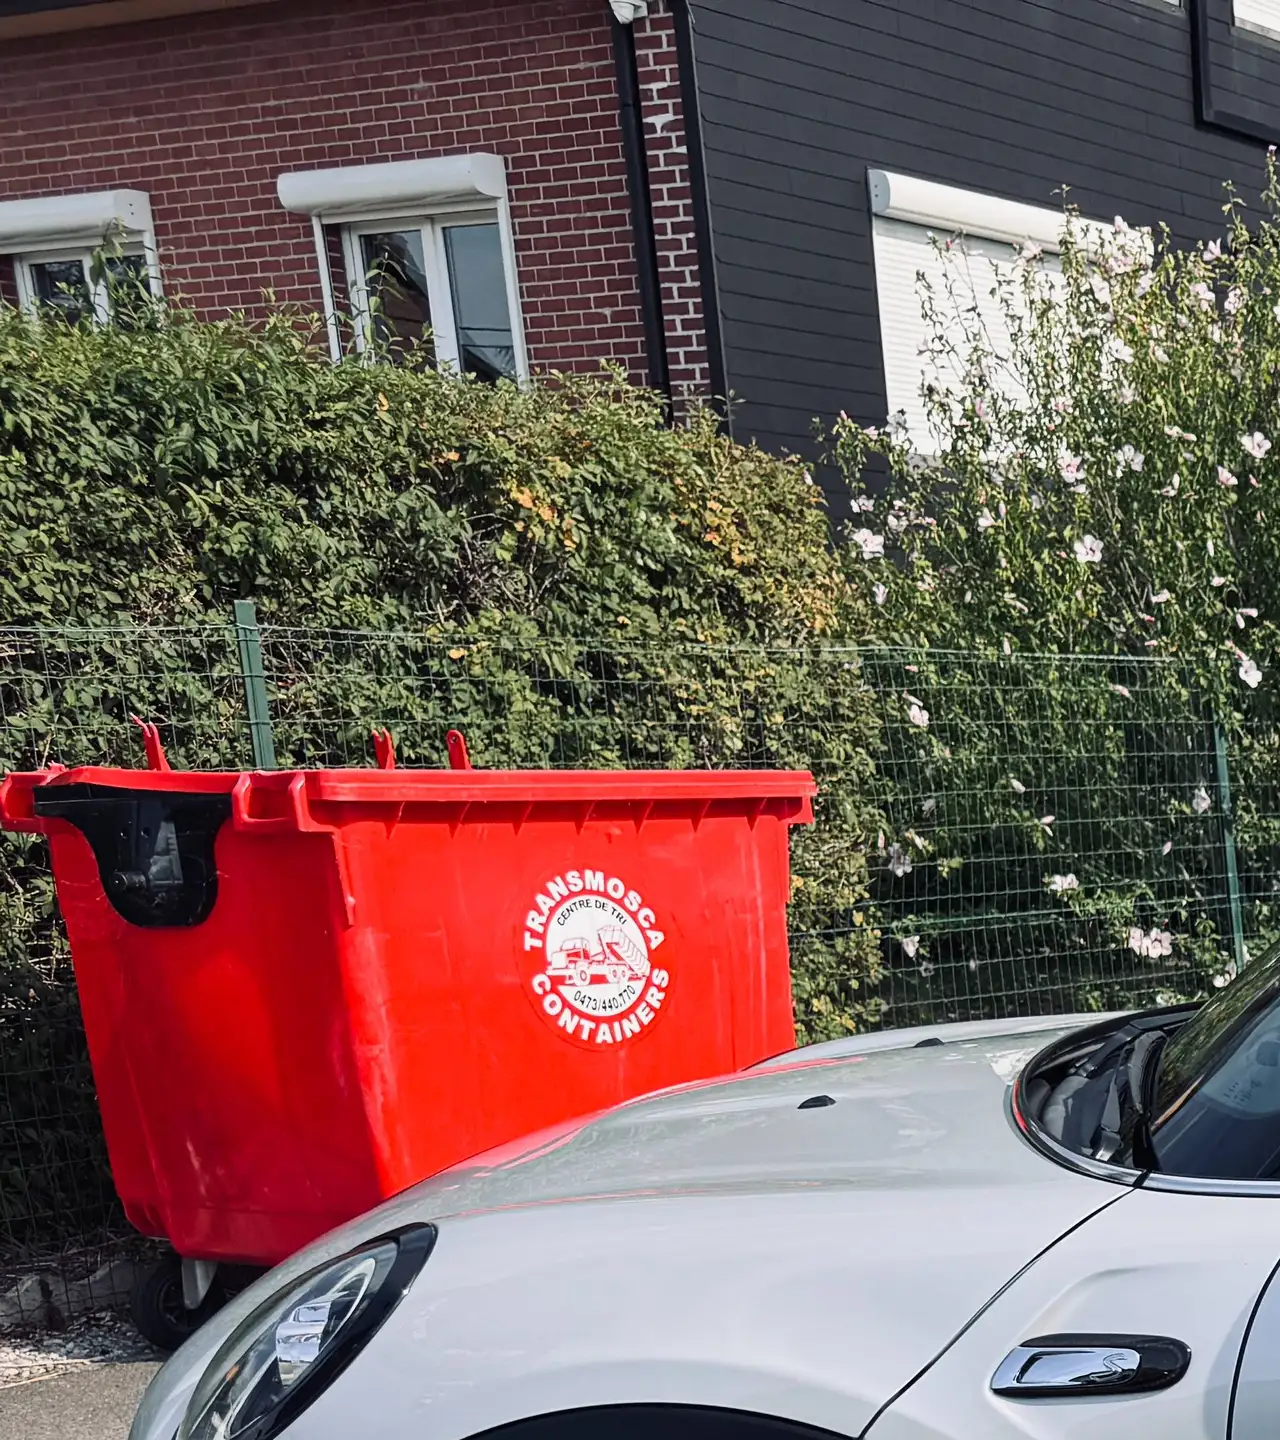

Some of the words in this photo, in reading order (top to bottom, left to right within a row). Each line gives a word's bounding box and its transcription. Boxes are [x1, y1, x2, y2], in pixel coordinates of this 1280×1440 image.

[524, 869, 665, 951] TRANSMOSCA
[557, 898, 592, 926] CENTRE
[595, 899, 610, 912] DE
[611, 906, 628, 925] TRI
[532, 968, 670, 1044] CONTAINERS
